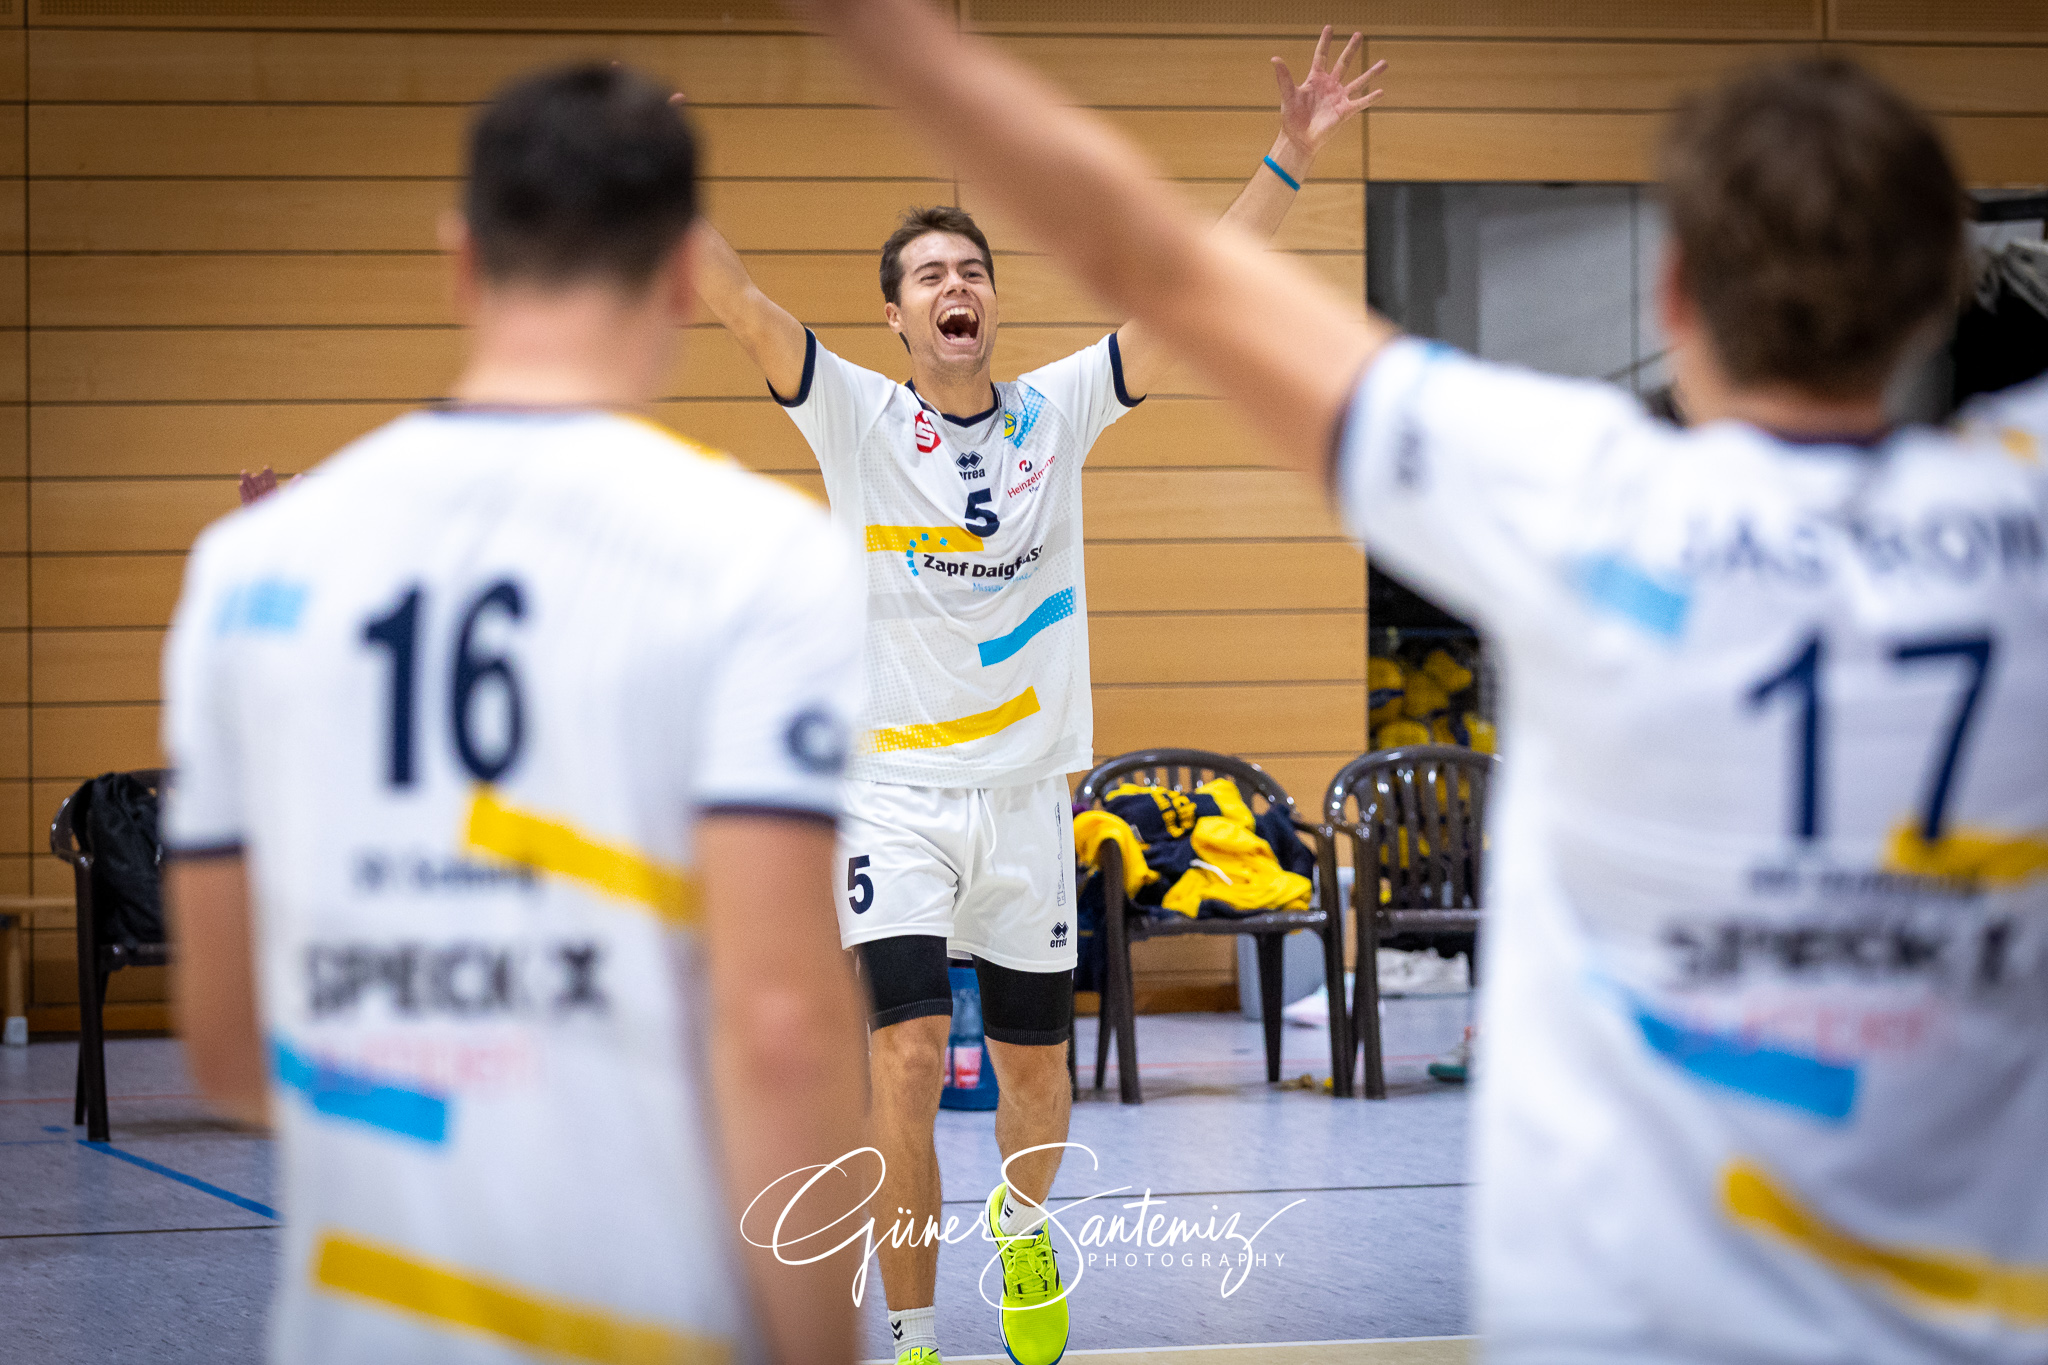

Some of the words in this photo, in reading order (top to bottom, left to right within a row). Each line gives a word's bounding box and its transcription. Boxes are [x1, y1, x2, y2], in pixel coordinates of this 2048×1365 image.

[965, 488, 1000, 538] 5
[923, 553, 969, 577] Zapf
[358, 578, 527, 792] 16
[1746, 630, 1995, 842] 17
[848, 855, 874, 915] 5
